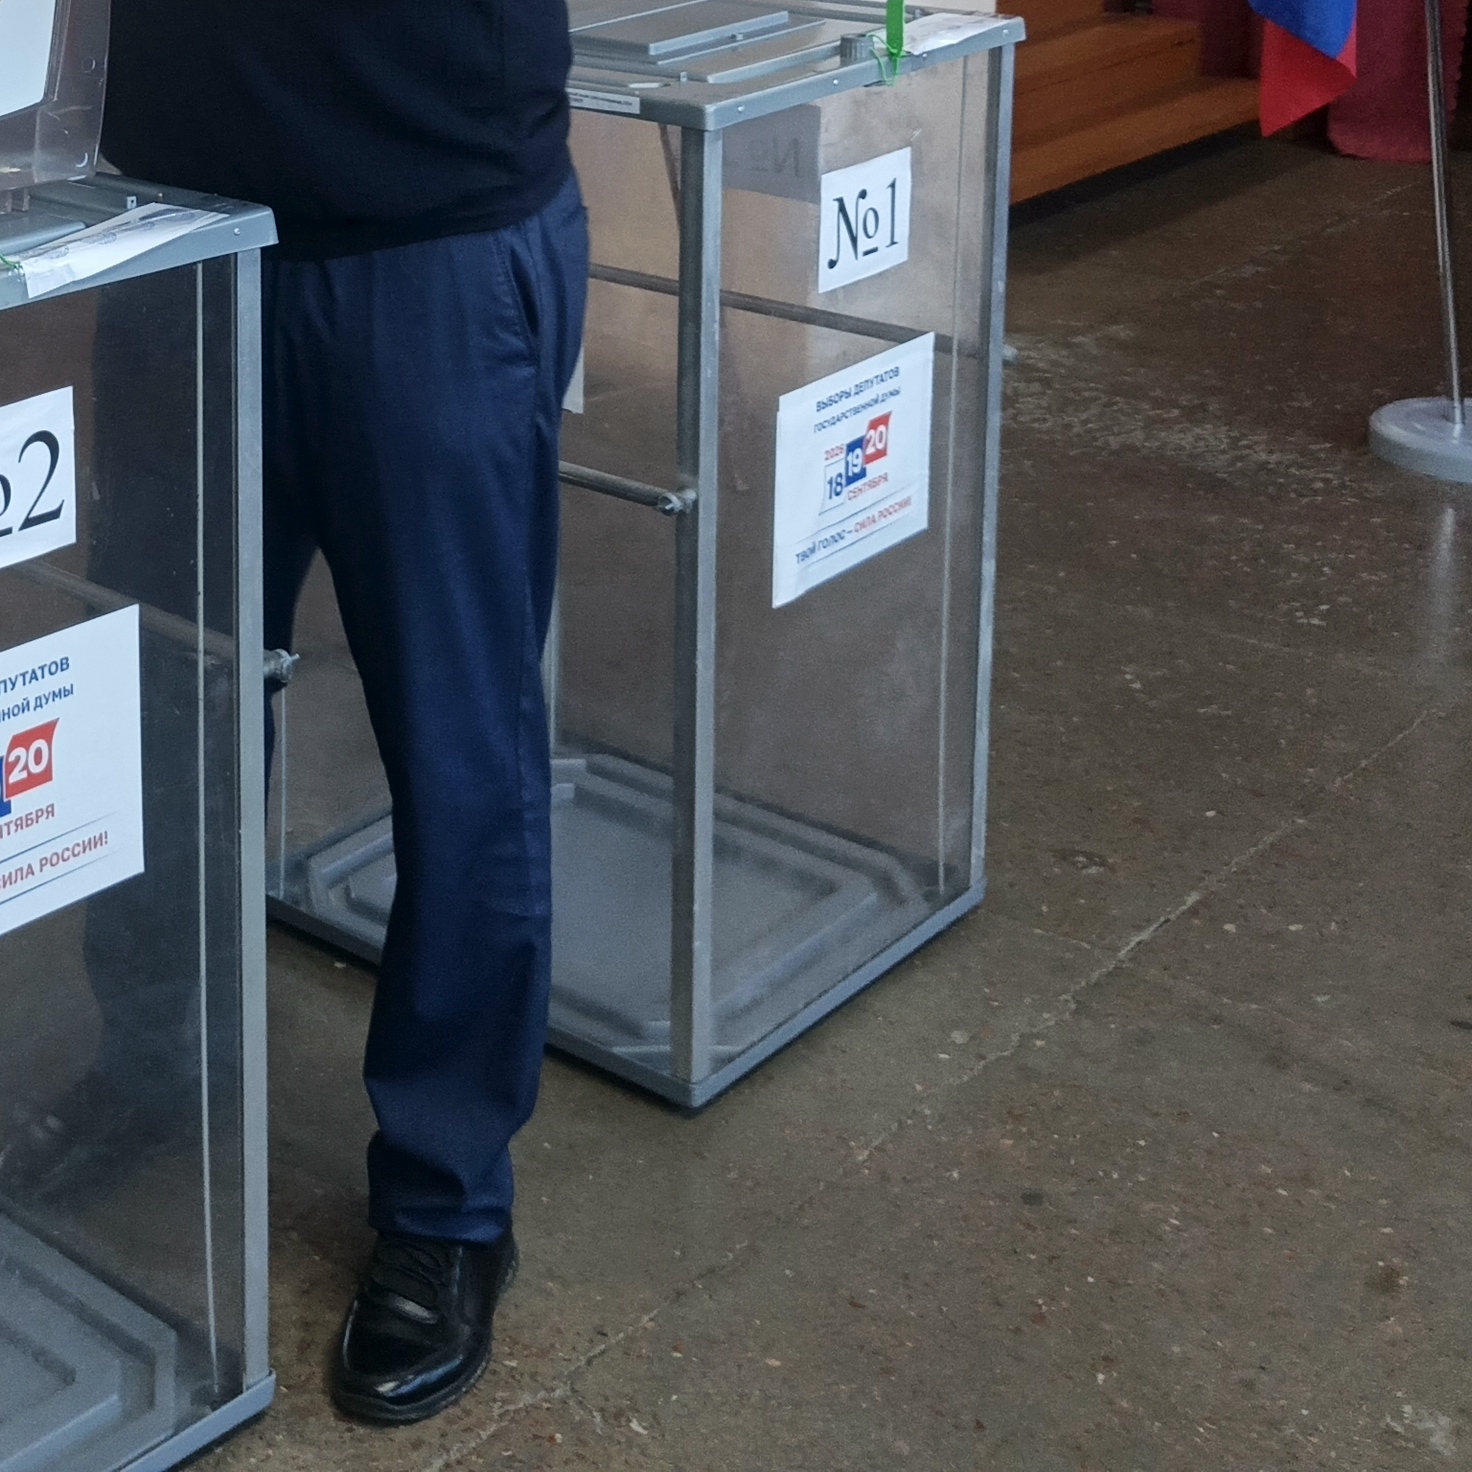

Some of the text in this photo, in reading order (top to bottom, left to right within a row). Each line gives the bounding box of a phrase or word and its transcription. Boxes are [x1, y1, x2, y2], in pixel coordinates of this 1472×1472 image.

[827, 177, 899, 269] №1
[816, 366, 899, 413] ВЫБОРЫ ДЕПУТАТОВ
[827, 424, 887, 500] 18 19 20
[33, 683, 74, 711] ДУМЫ
[8, 738, 50, 784] 20
[39, 830, 109, 872] РОССИИ!
